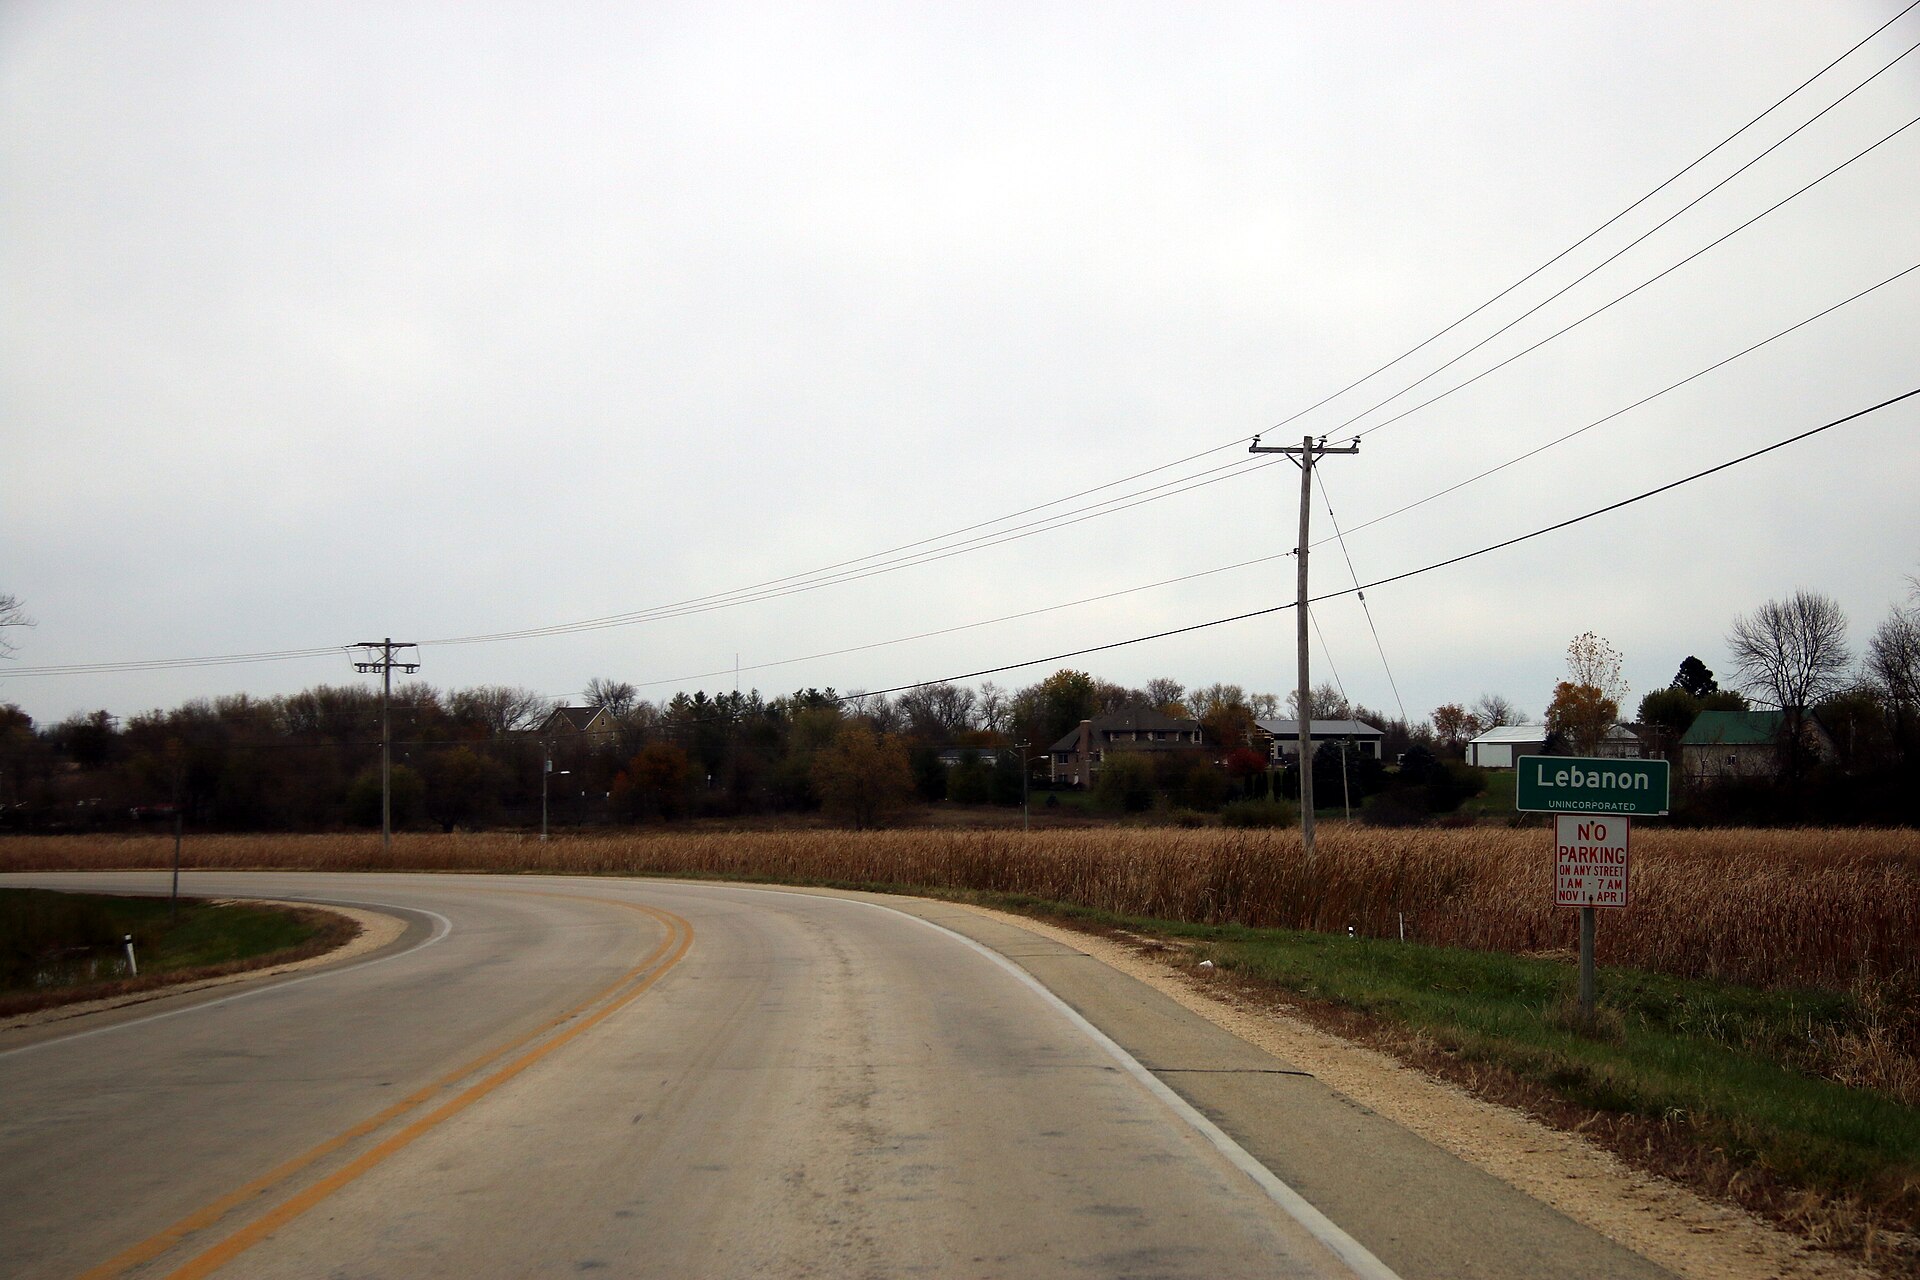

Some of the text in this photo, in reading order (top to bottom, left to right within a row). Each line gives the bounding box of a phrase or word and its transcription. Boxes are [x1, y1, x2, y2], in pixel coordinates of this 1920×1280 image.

[1537, 764, 1649, 790] Lebanon
[1548, 800, 1636, 811] UNINCORPORATED
[1578, 824, 1606, 841] NO
[1559, 846, 1625, 864] PARKING
[1560, 865, 1623, 877] ON ANY STREET
[1560, 878, 1564, 888] 1
[1567, 878, 1582, 889] AM
[1598, 879, 1604, 889] 7
[1607, 879, 1622, 890] AM
[1559, 891, 1578, 901] NOV
[1582, 891, 1586, 901] 1
[1597, 892, 1617, 902] APR
